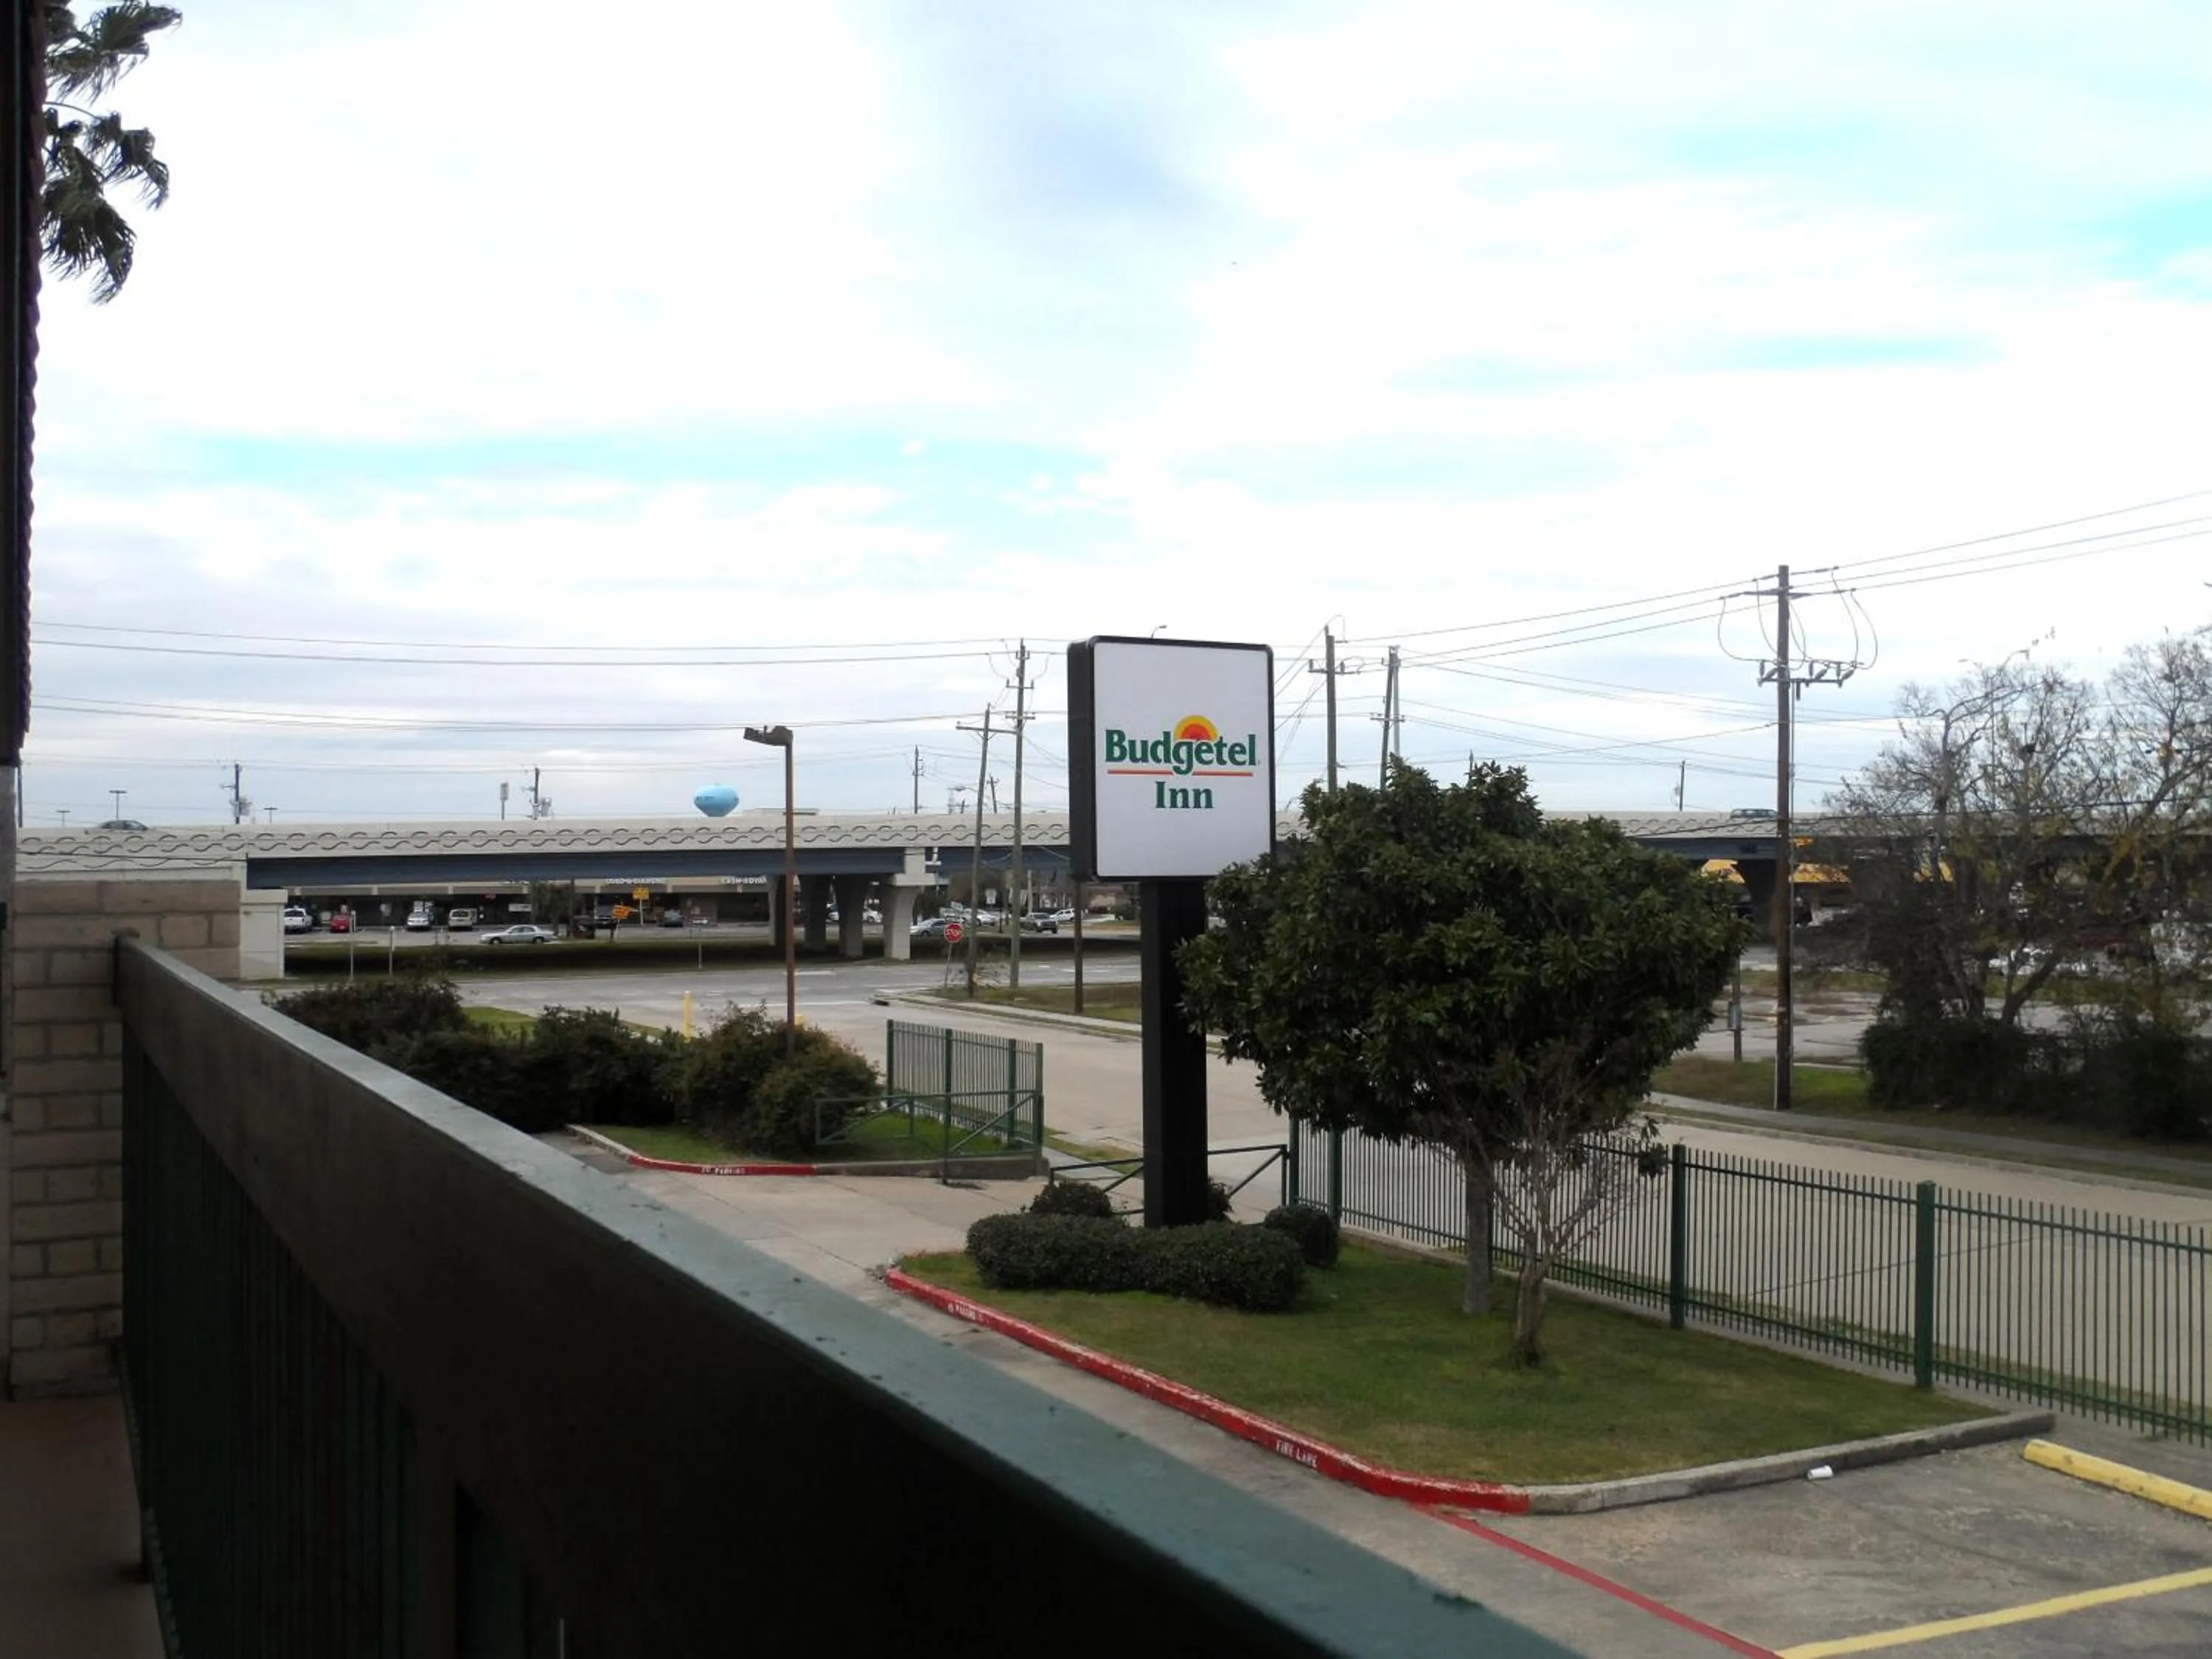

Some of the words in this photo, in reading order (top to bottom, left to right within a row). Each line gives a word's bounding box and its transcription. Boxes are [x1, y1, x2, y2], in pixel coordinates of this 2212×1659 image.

[1105, 728, 1257, 775] Budgetel
[1155, 781, 1214, 809] Inn
[946, 928, 963, 936] STOP
[1276, 1439, 1293, 1458] FIRE
